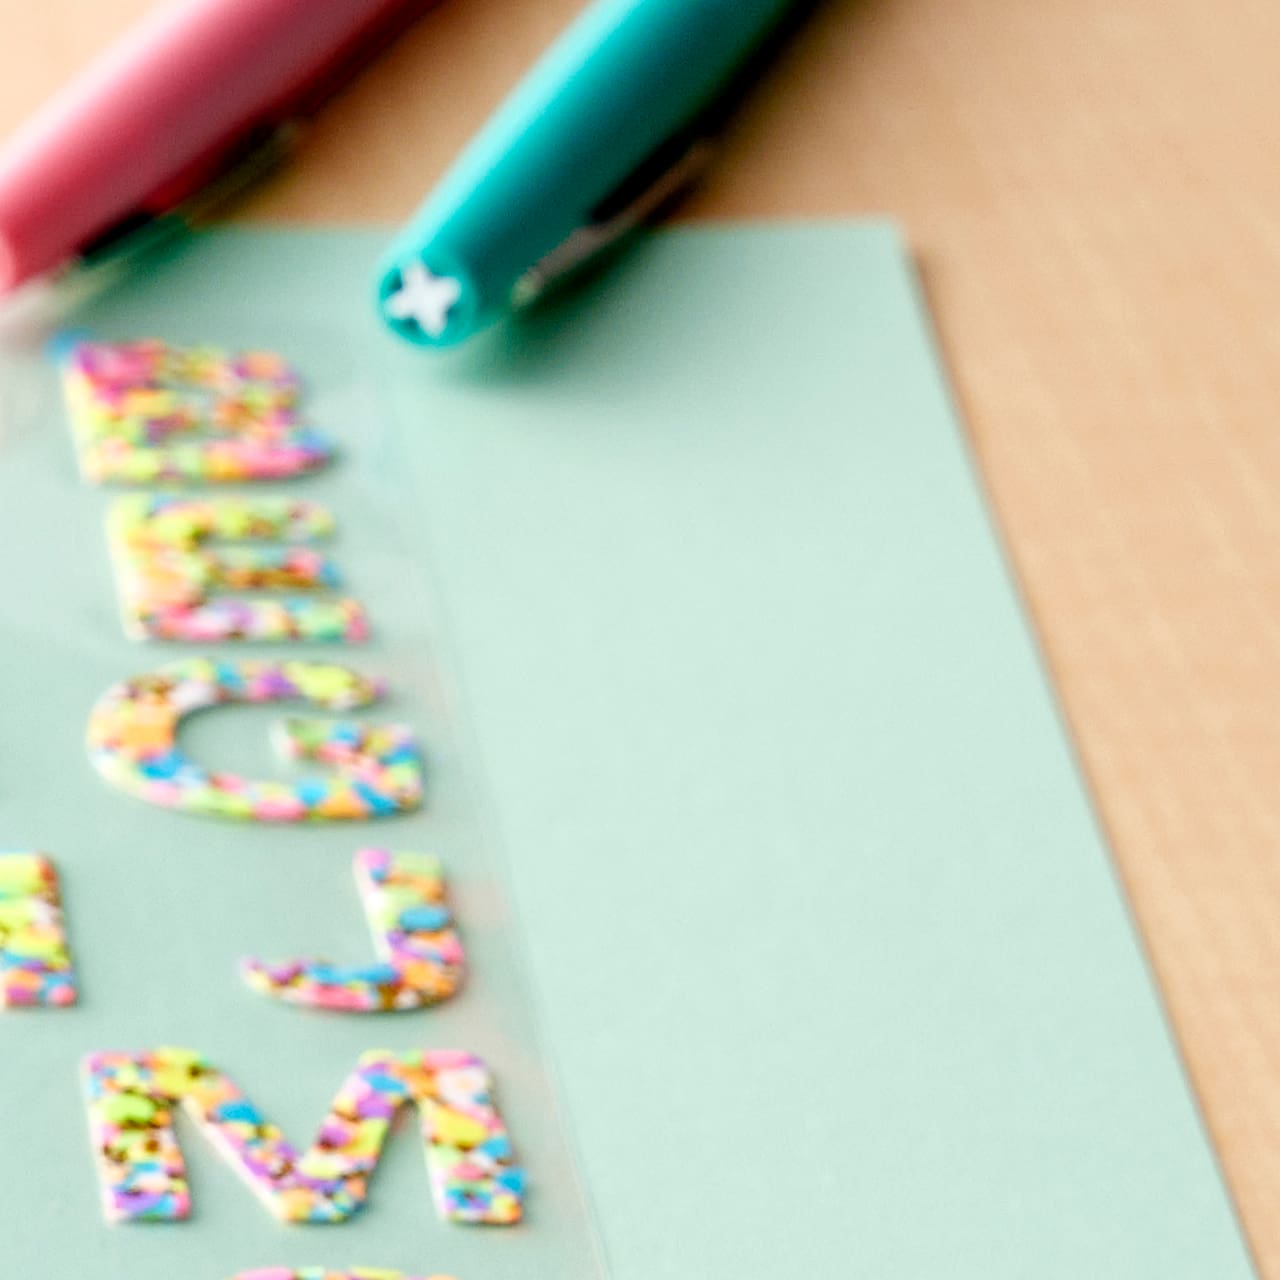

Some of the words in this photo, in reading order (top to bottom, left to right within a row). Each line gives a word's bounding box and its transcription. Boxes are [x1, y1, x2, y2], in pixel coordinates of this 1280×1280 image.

[104, 493, 375, 642] E
[86, 656, 426, 823] G
[242, 847, 466, 1013] J
[82, 1048, 530, 1224] M
